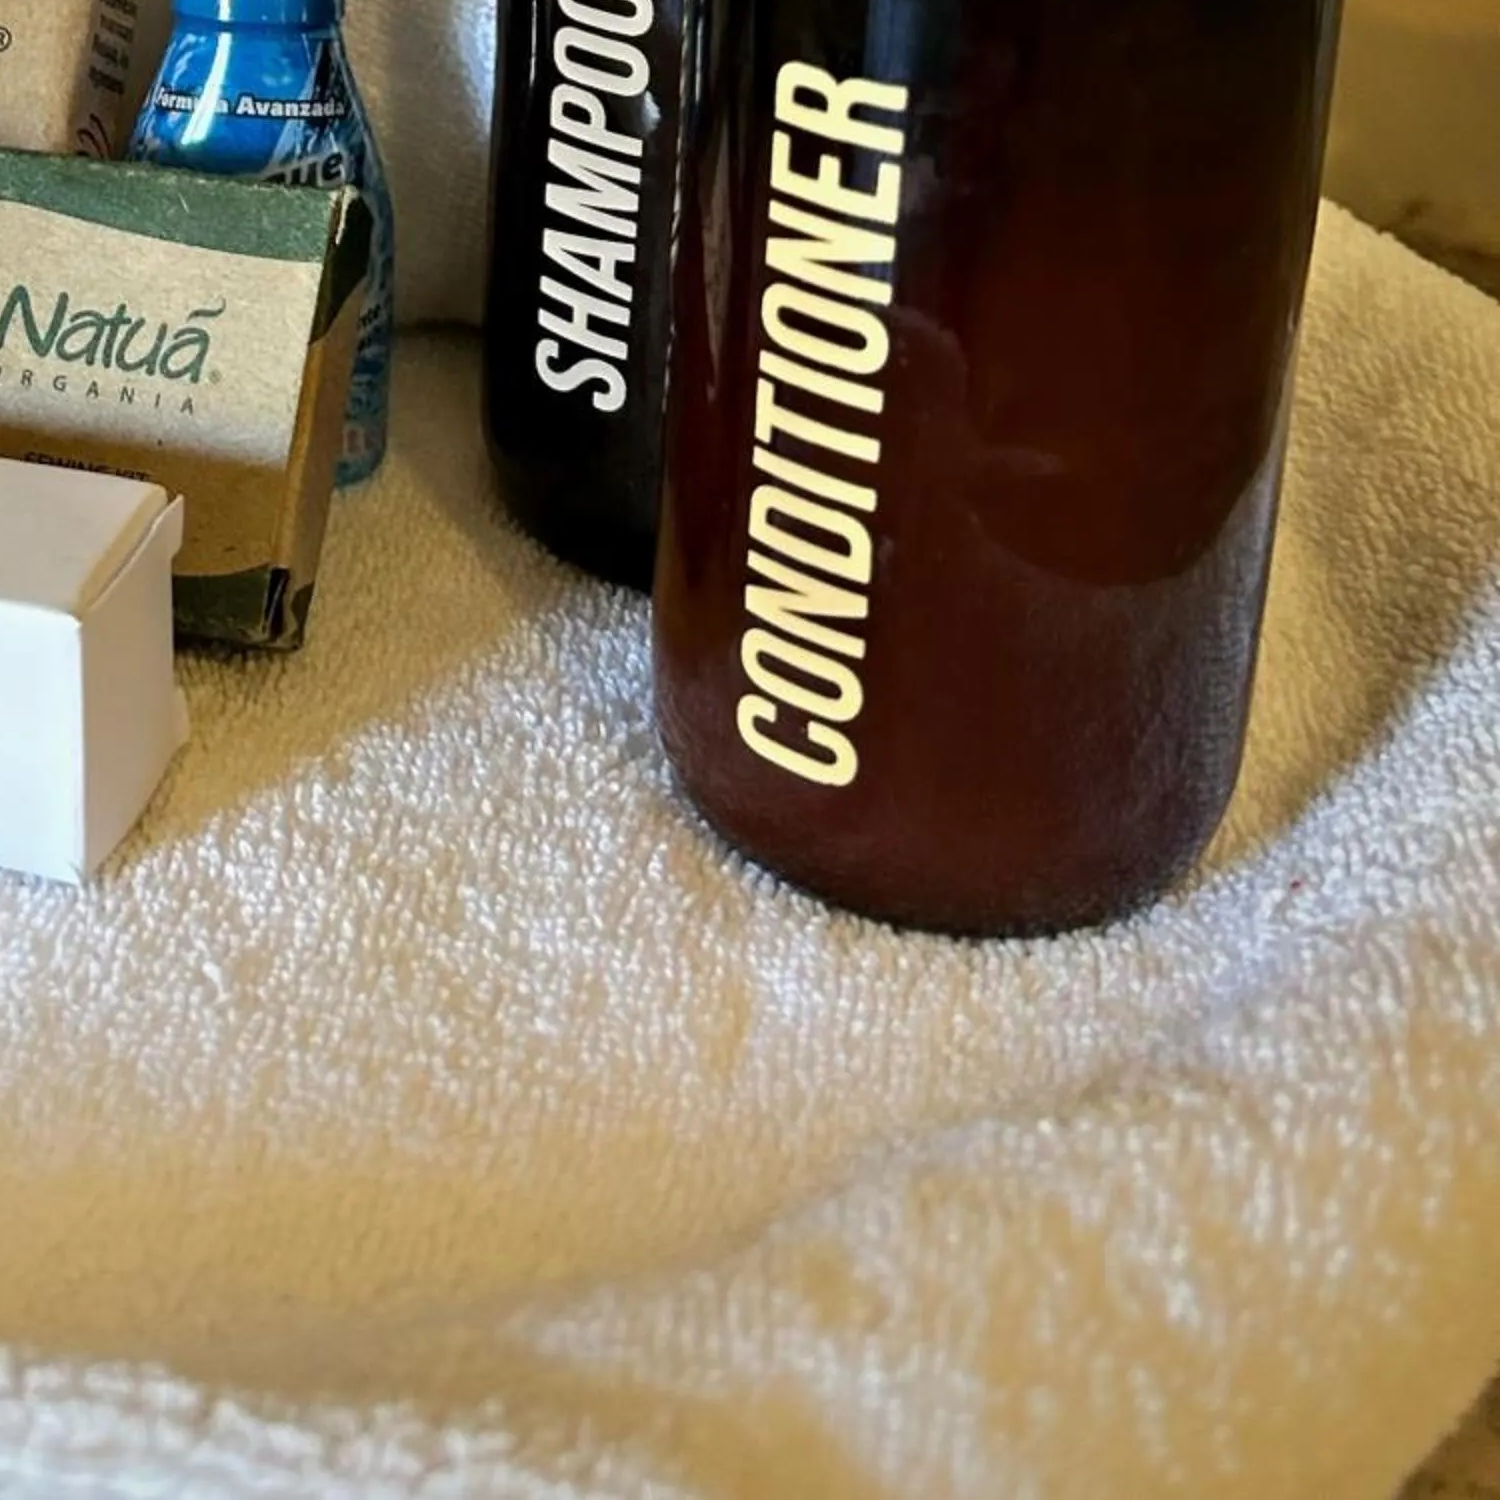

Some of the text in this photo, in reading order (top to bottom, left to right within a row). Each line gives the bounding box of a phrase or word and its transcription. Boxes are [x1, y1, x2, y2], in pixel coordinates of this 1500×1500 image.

[156, 87, 346, 118] Forma Avanzada
[737, 60, 908, 787] CONDITIONER
